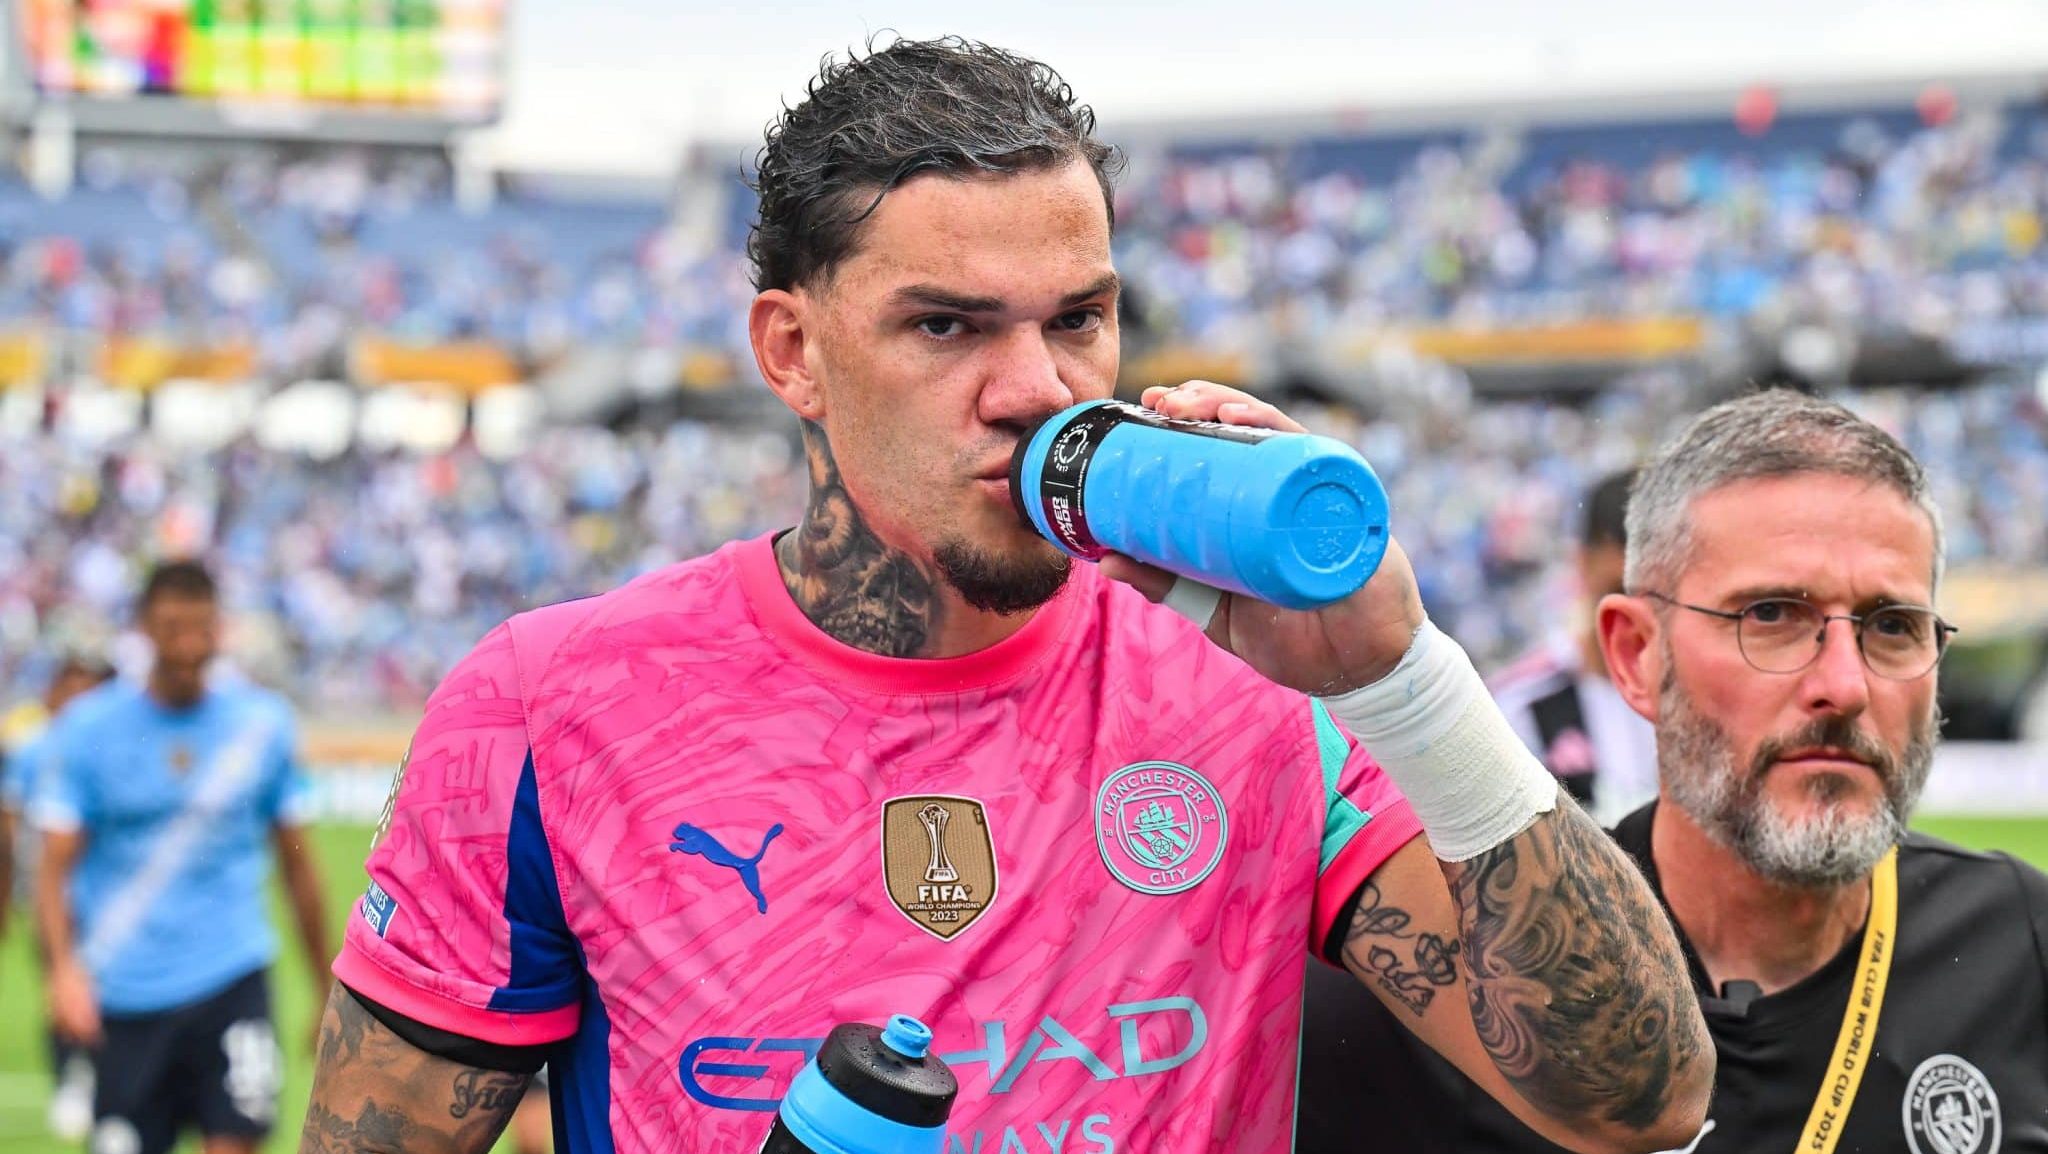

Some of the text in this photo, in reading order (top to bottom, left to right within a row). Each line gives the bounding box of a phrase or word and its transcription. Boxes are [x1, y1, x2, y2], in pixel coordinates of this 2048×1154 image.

[1103, 771, 1206, 816] MANCHESTER
[1149, 867, 1188, 885] CITY
[917, 884, 970, 902] FIFA
[907, 902, 981, 911] WORLD CHAMPIONS
[930, 910, 960, 922] 2023
[1811, 929, 1885, 1151] FIFA CLUB WORLD CUP 2025
[678, 995, 1208, 1113] ETHAD
